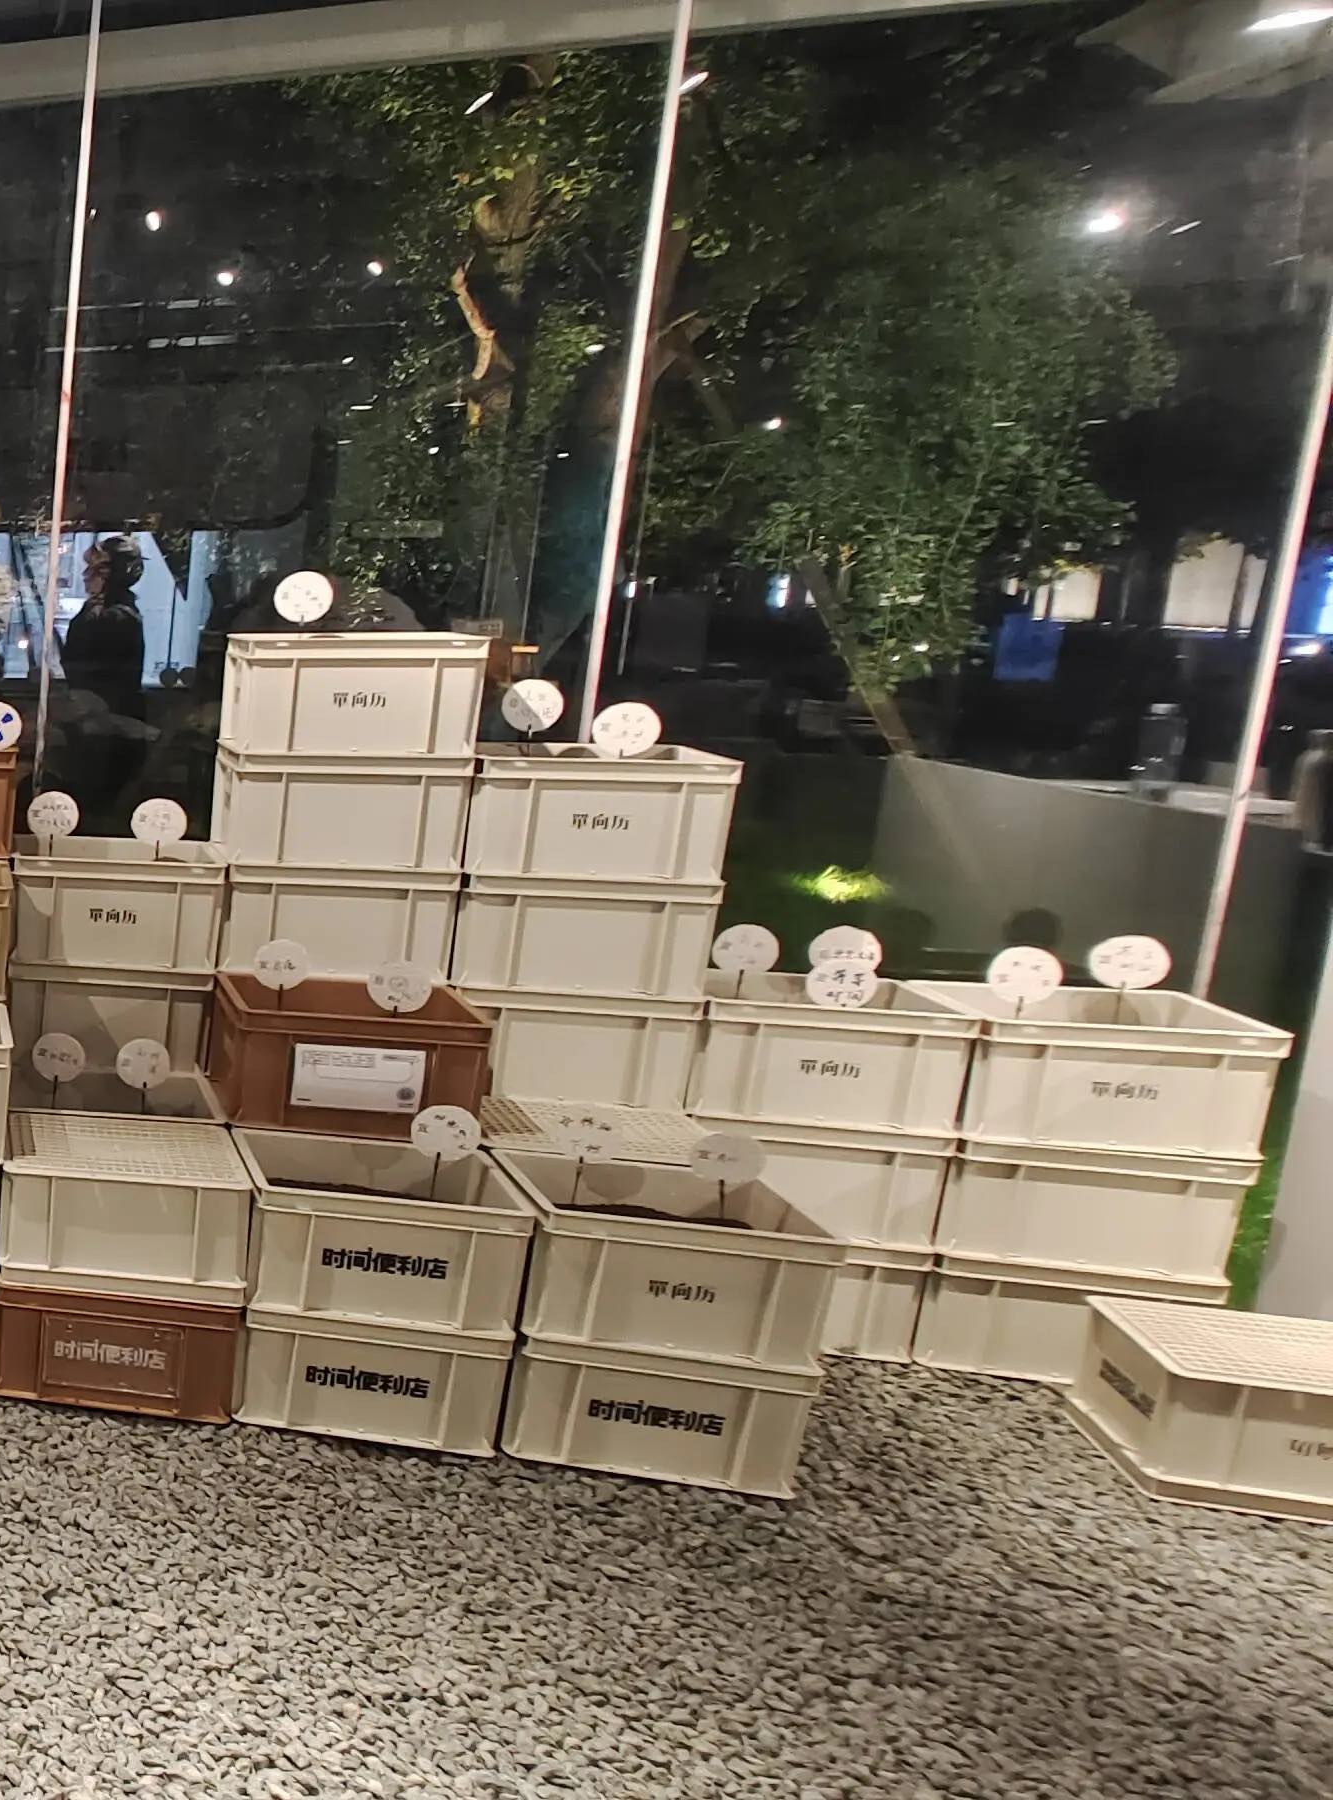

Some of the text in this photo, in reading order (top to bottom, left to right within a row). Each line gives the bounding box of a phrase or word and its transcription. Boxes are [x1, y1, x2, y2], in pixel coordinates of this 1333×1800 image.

[321, 1246, 450, 1281] 时间便利店
[53, 1339, 167, 1372] 时间便利店
[304, 1363, 432, 1400] 时间便利店
[587, 1398, 725, 1438] 时间便利店
